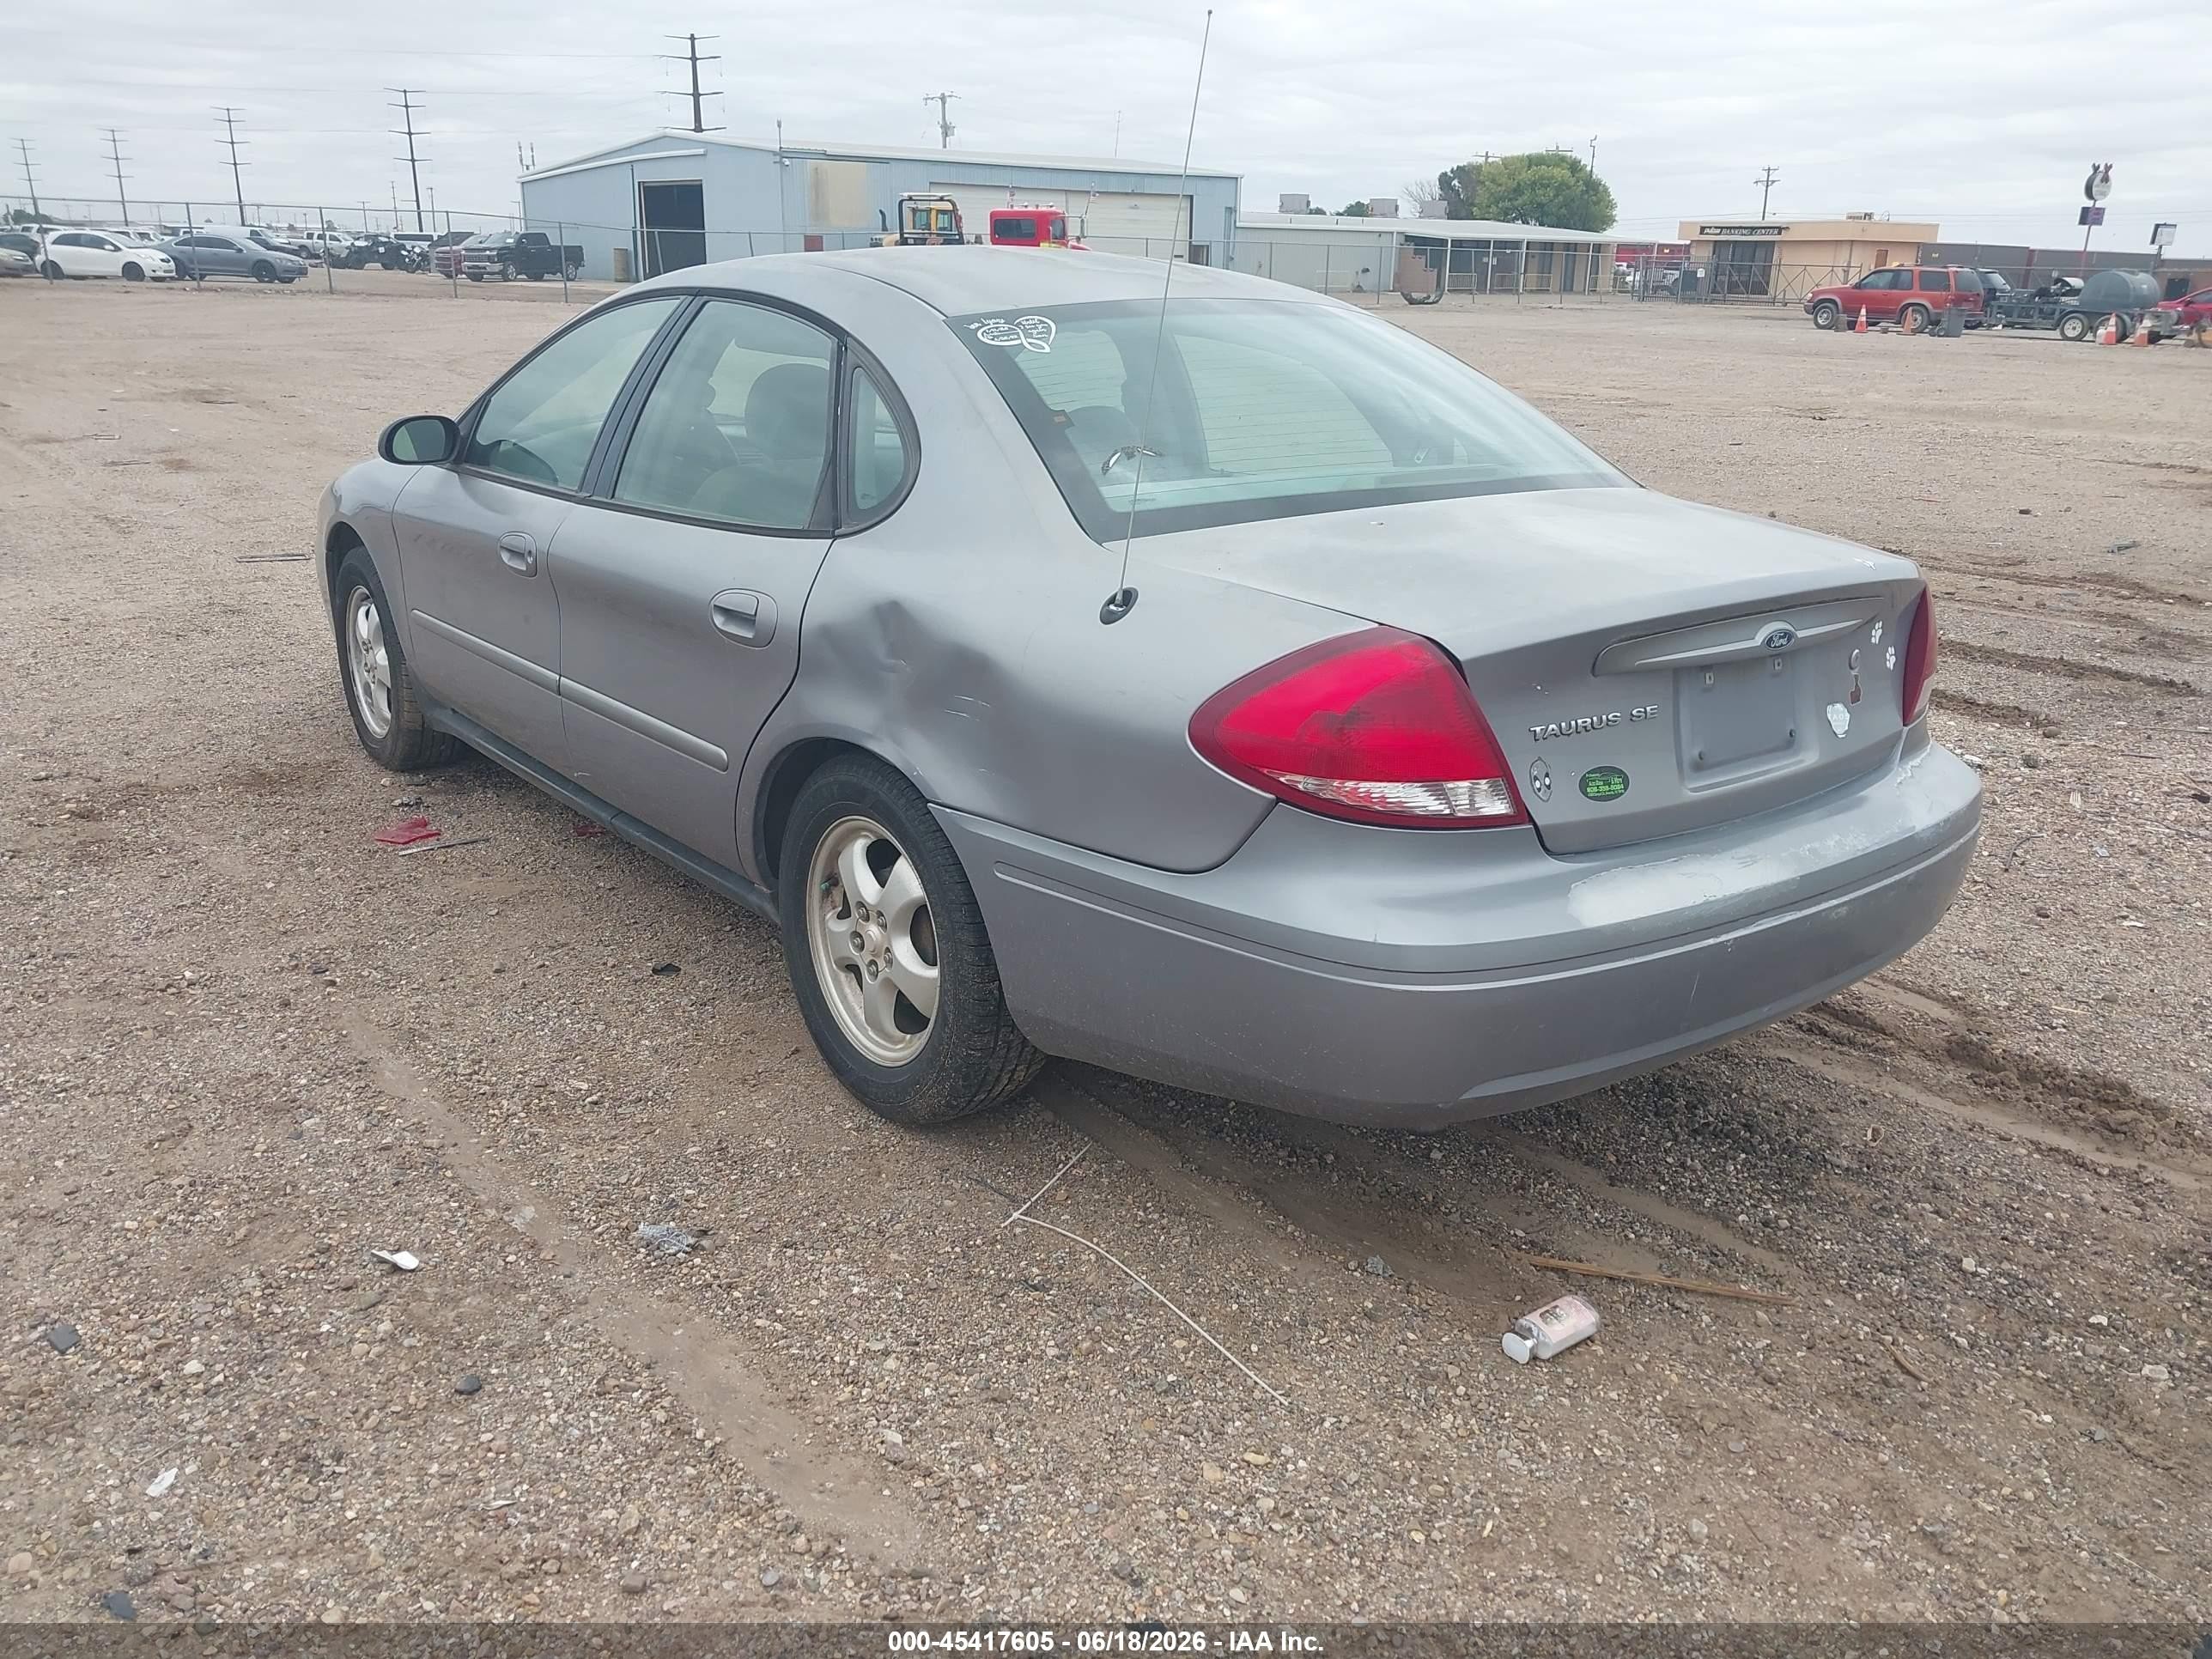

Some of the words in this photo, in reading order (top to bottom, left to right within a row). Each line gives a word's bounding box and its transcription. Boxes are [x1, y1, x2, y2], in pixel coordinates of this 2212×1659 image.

[1771, 632, 1789, 647] Ford
[1528, 712, 1621, 742] TAURUS
[1630, 704, 1659, 722] SE
